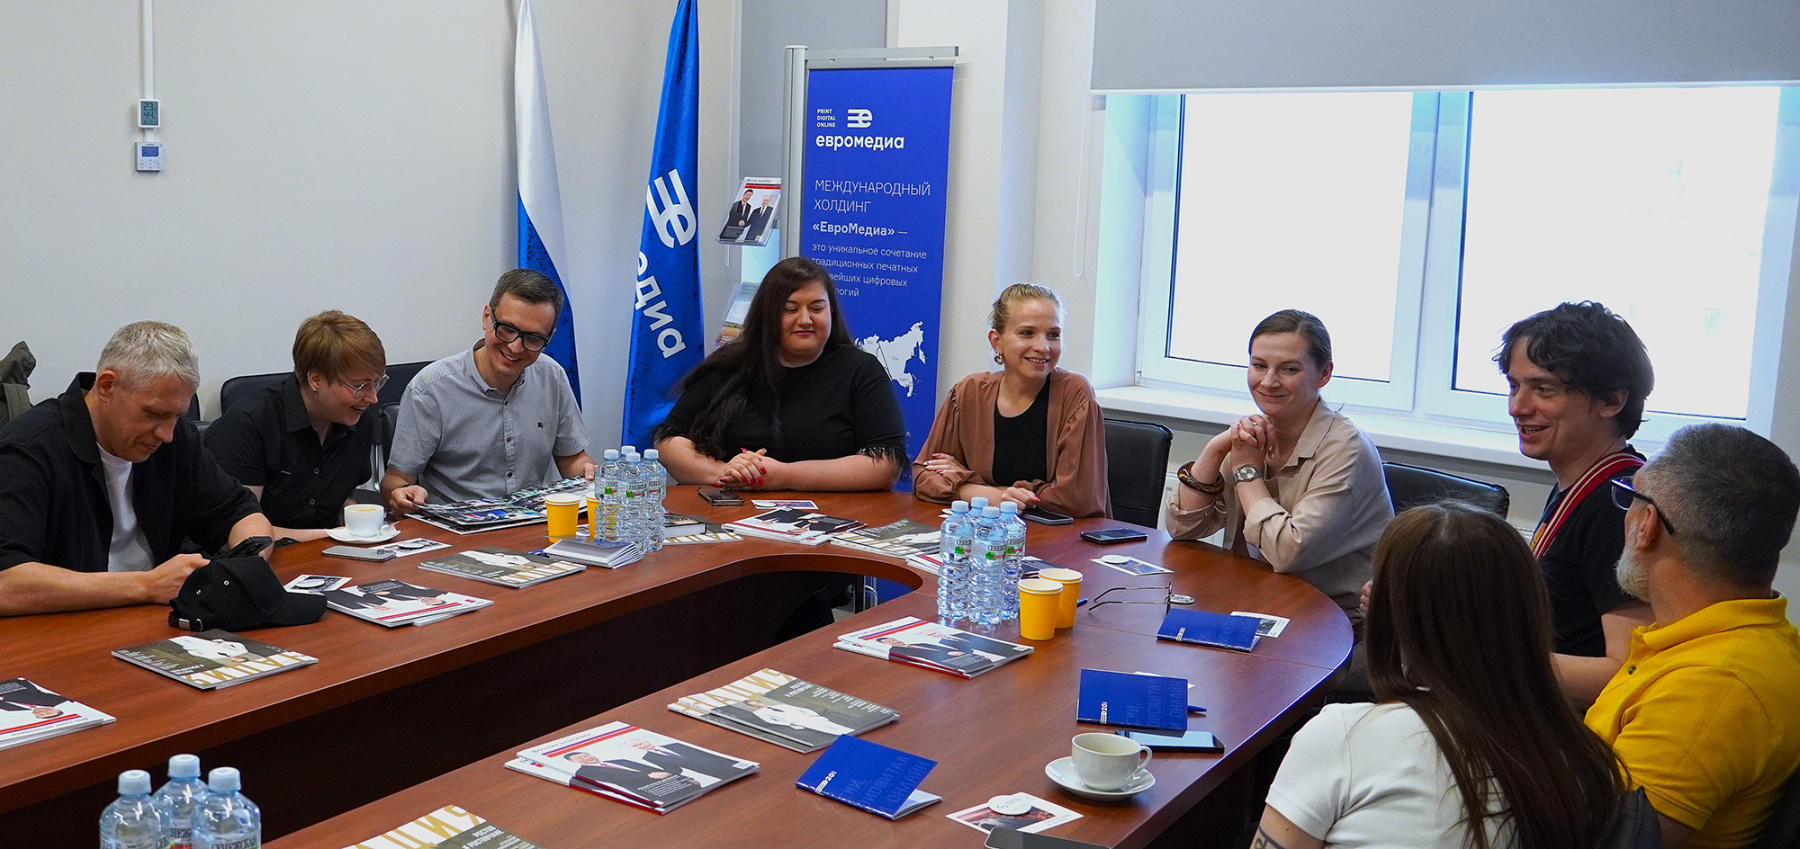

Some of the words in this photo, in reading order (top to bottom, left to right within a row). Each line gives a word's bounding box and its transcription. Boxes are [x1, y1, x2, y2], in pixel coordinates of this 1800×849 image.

[815, 135, 905, 151] евромедиа
[814, 179, 931, 197] МЕЖДУНАРОДНЫЙ
[813, 198, 872, 214] ХОЛДИНГ
[812, 221, 895, 237] «ЕвроМедиа»
[811, 243, 827, 252] это
[828, 244, 879, 256] уникальное
[880, 247, 927, 259] сочетание
[876, 262, 919, 273] печатных
[828, 272, 861, 283] вейших
[862, 275, 908, 288] цифровых
